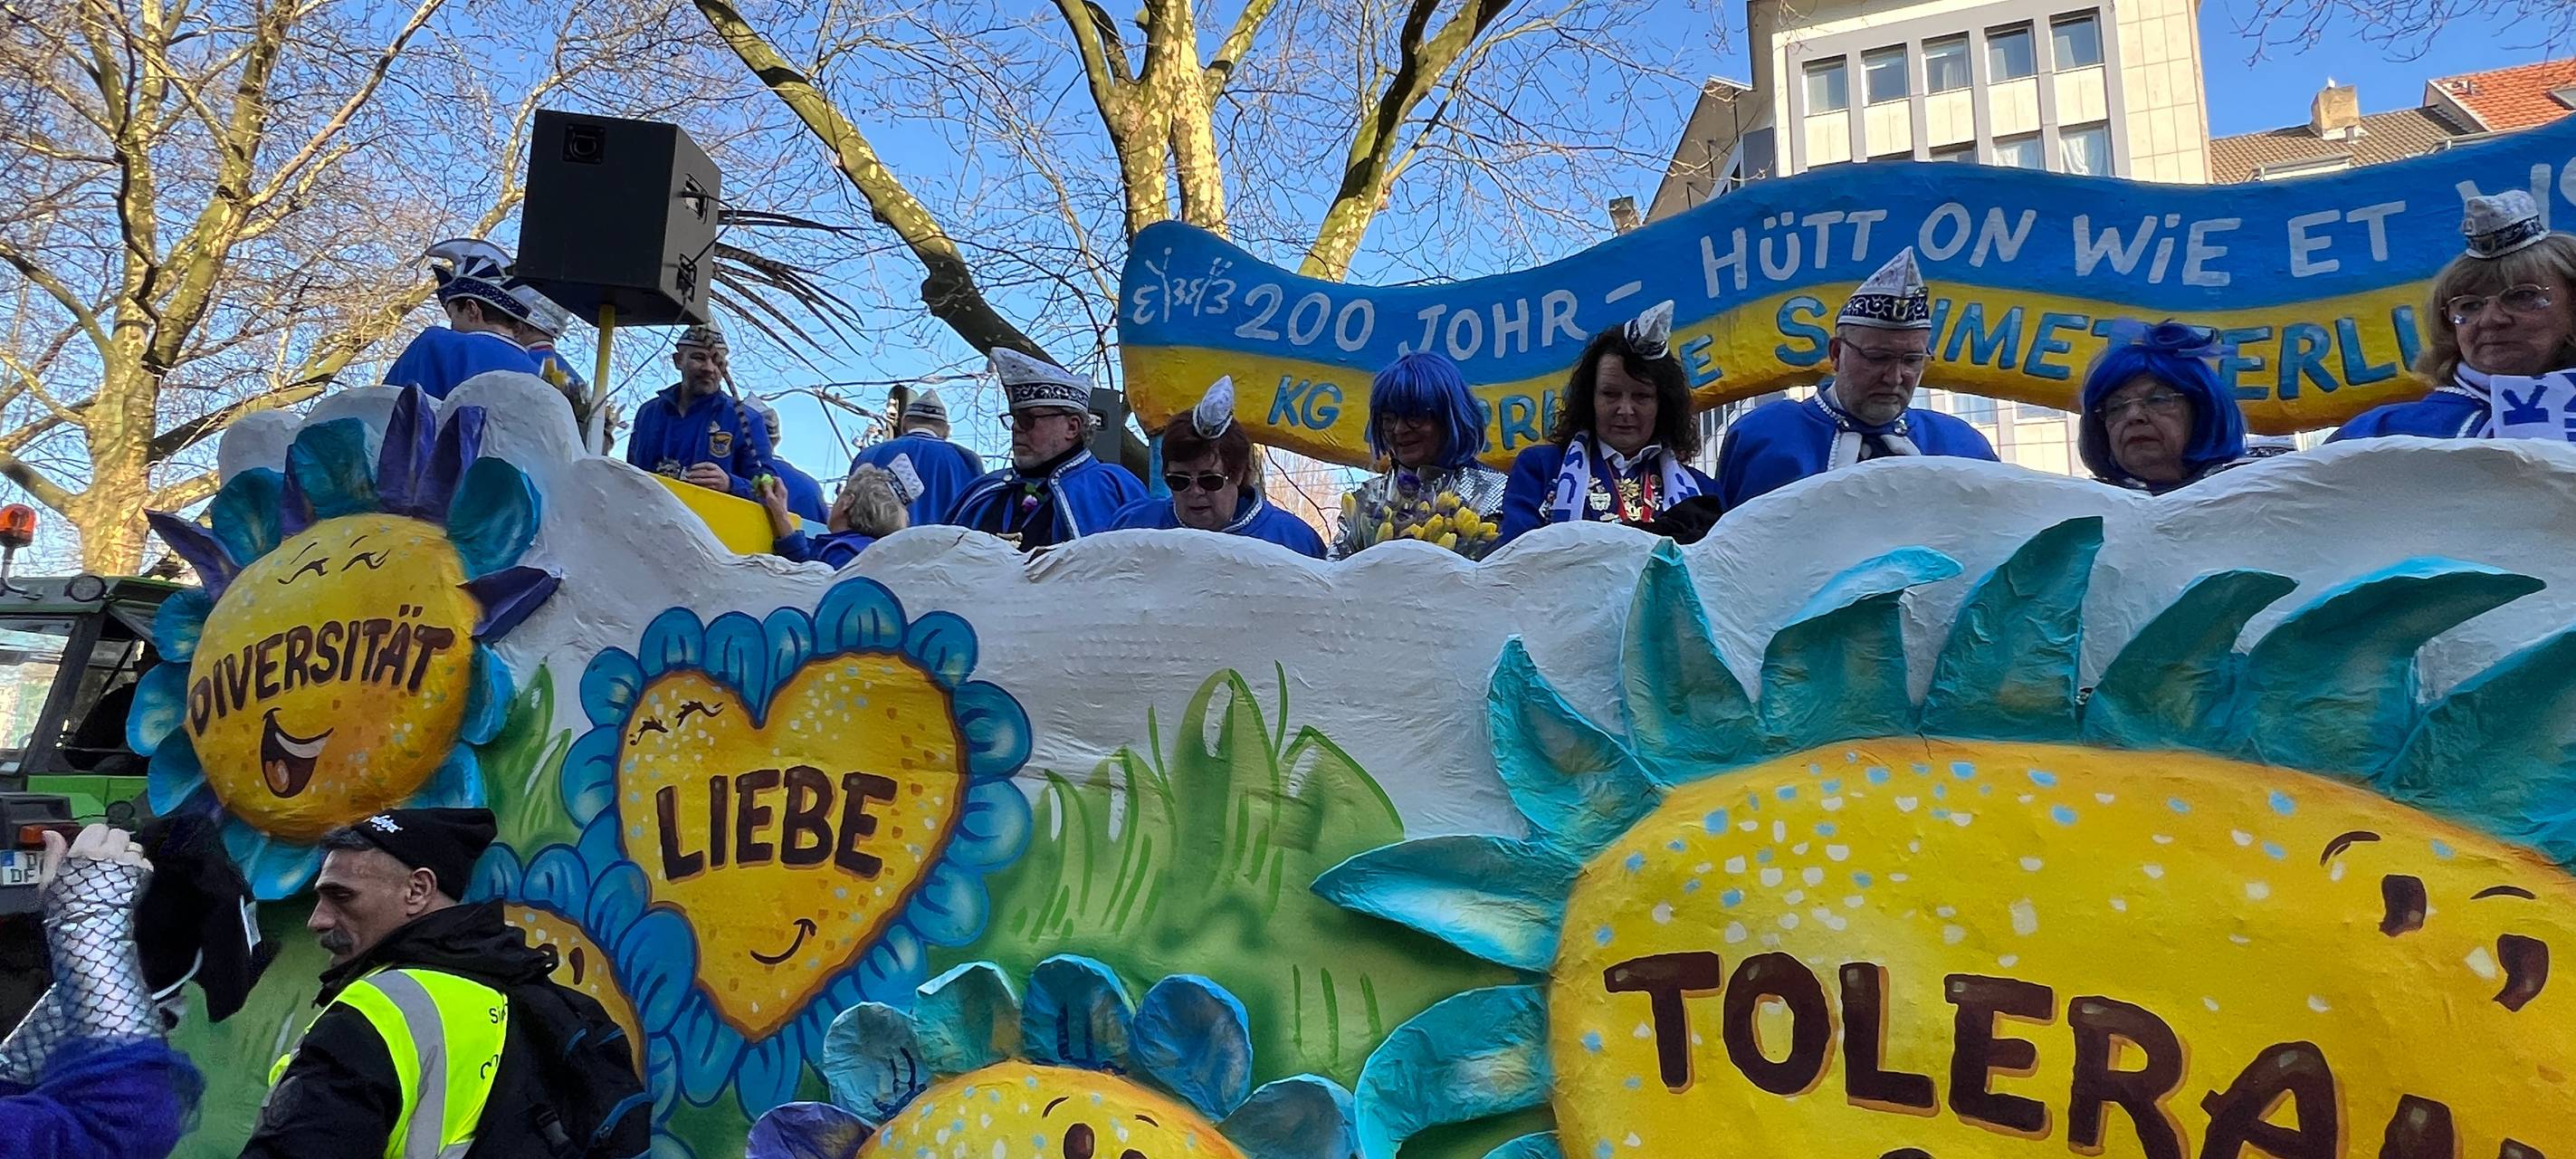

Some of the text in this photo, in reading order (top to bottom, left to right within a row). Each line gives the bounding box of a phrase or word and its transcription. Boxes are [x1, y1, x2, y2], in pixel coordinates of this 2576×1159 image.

[1235, 283, 1376, 352] 200
[1398, 289, 1589, 361] JOHR
[1700, 208, 1888, 299] HÜTT
[1918, 201, 2037, 268] ON
[2286, 199, 2407, 278] ET
[1267, 375, 1343, 431] KG
[189, 604, 455, 738] DIVERSITÄT
[655, 764, 899, 884] LIEBE
